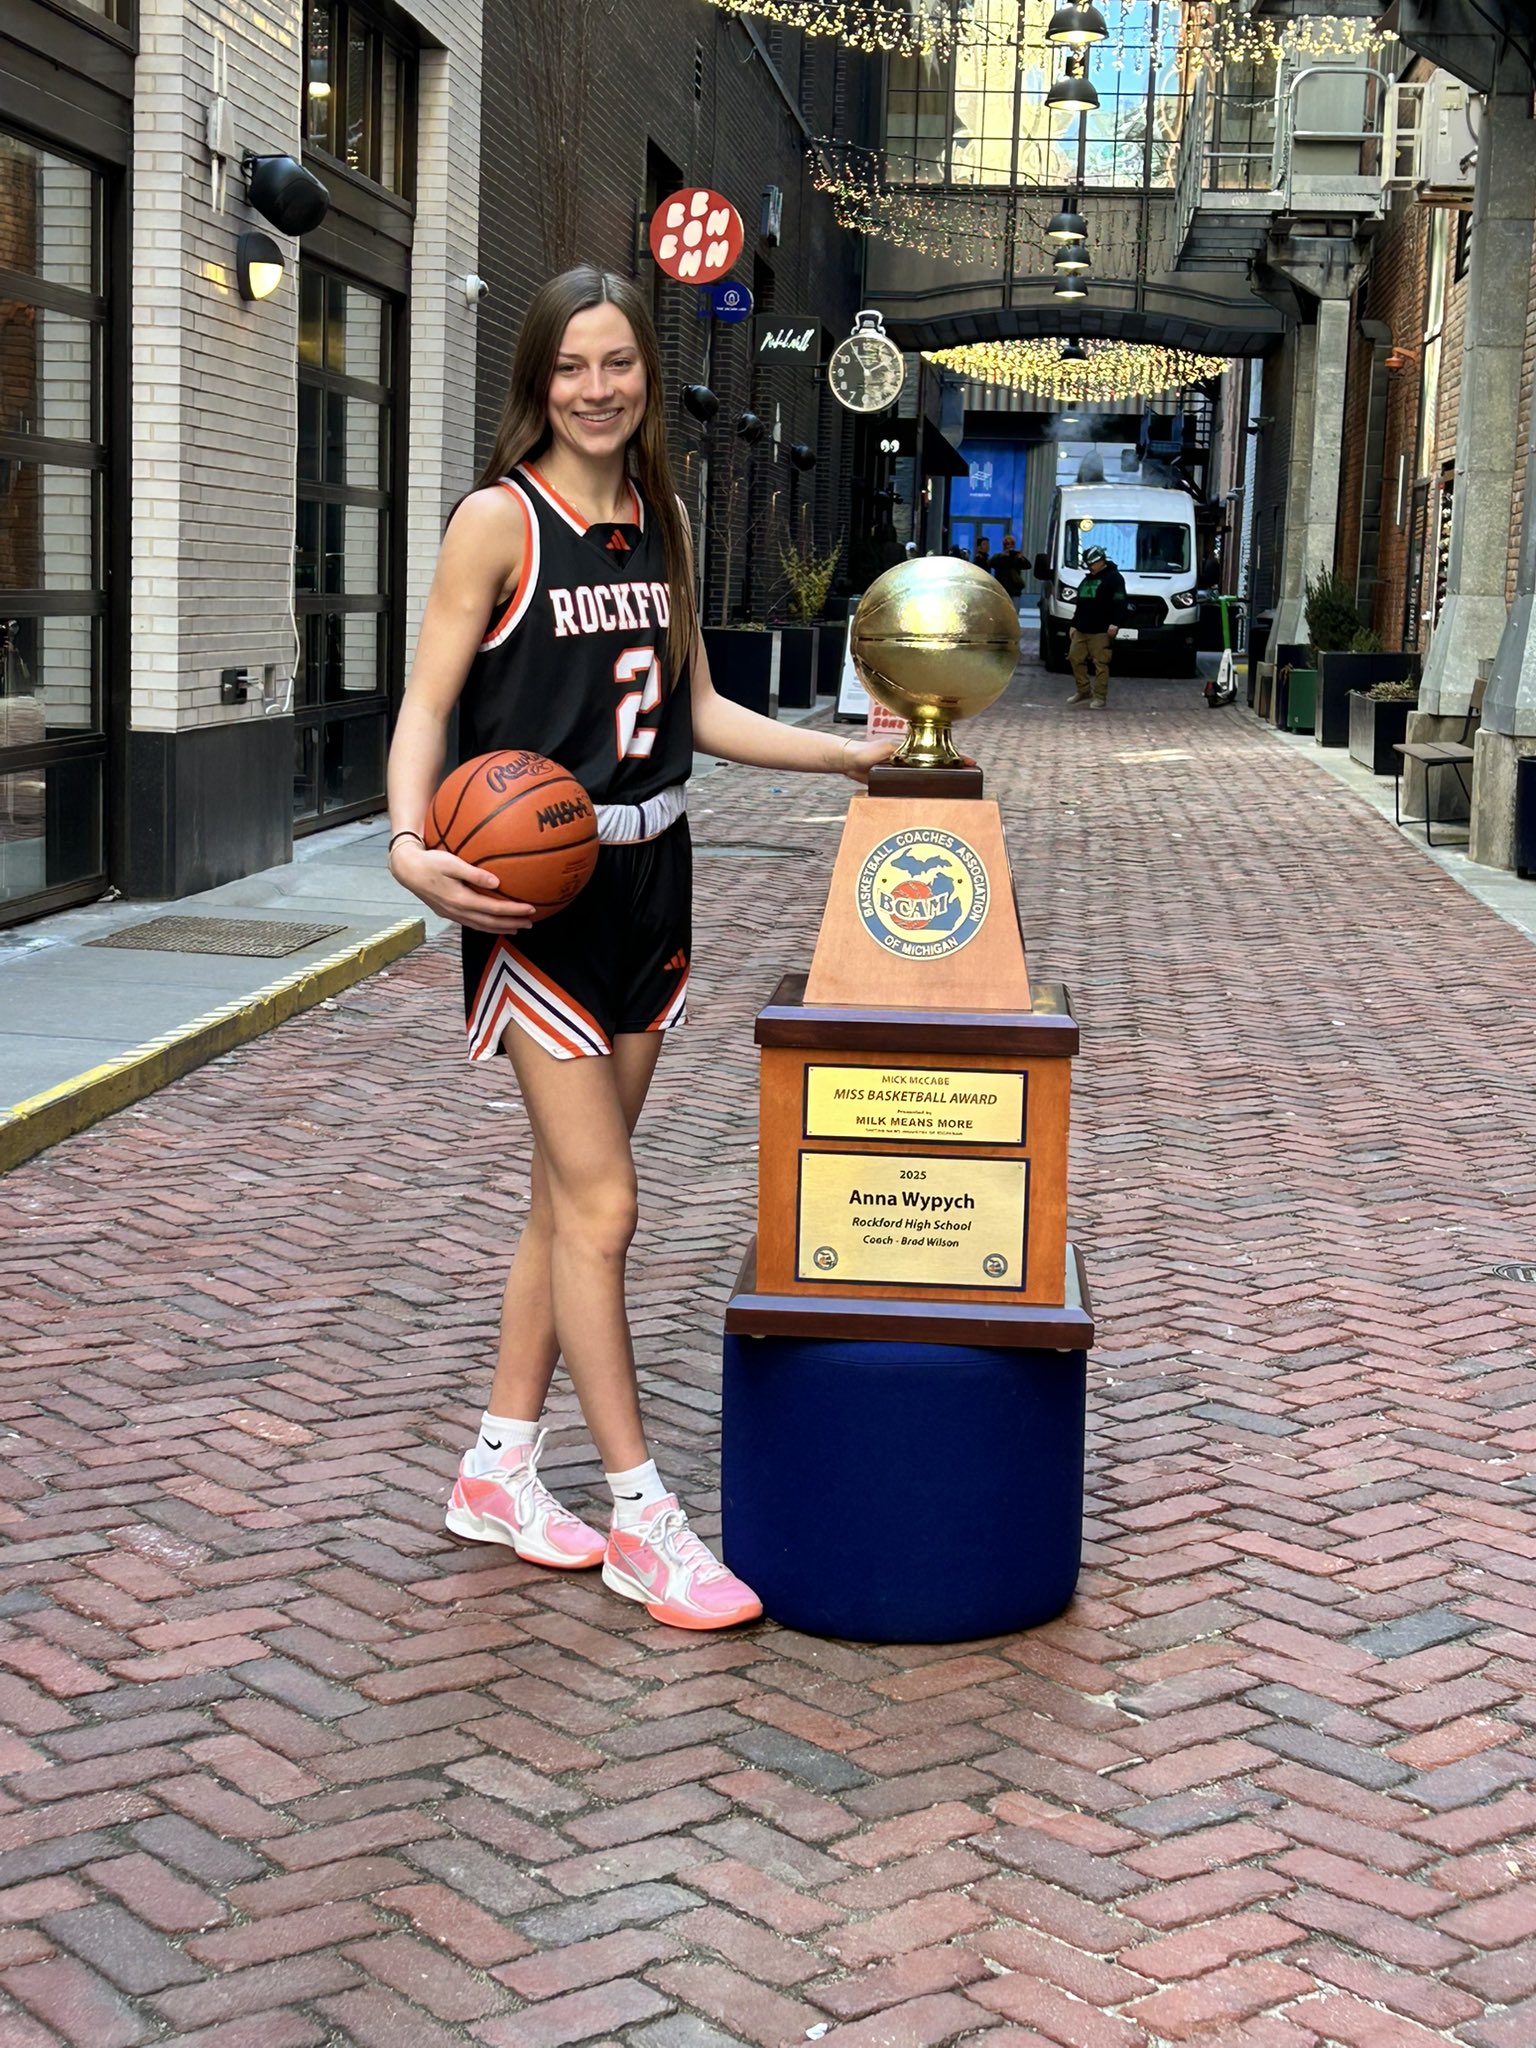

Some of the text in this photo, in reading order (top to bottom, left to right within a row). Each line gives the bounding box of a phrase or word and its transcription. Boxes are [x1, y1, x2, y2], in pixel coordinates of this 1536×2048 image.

[840, 355, 850, 364] 10
[837, 368, 844, 377] 9
[840, 381, 847, 390] 8
[548, 582, 671, 637] ROCKFO
[613, 645, 662, 761] 2
[860, 831, 988, 922] BASKETBALL COACHES ASSOCIATION
[879, 891, 949, 921] BCAM
[884, 935, 959, 955] OF MICHIGAN
[881, 1075, 907, 1085] MICK
[833, 1088, 998, 1105] MISS BASKETBALL AWARD
[856, 1116, 974, 1129] MILK MEANS MORE
[899, 1170, 927, 1180] 2025
[849, 1189, 975, 1212] Anna Wypych
[852, 1216, 972, 1231] Rockford High School
[862, 1234, 894, 1245] Coach
[901, 1236, 925, 1246] Brad
[926, 1237, 959, 1248] Wilson
